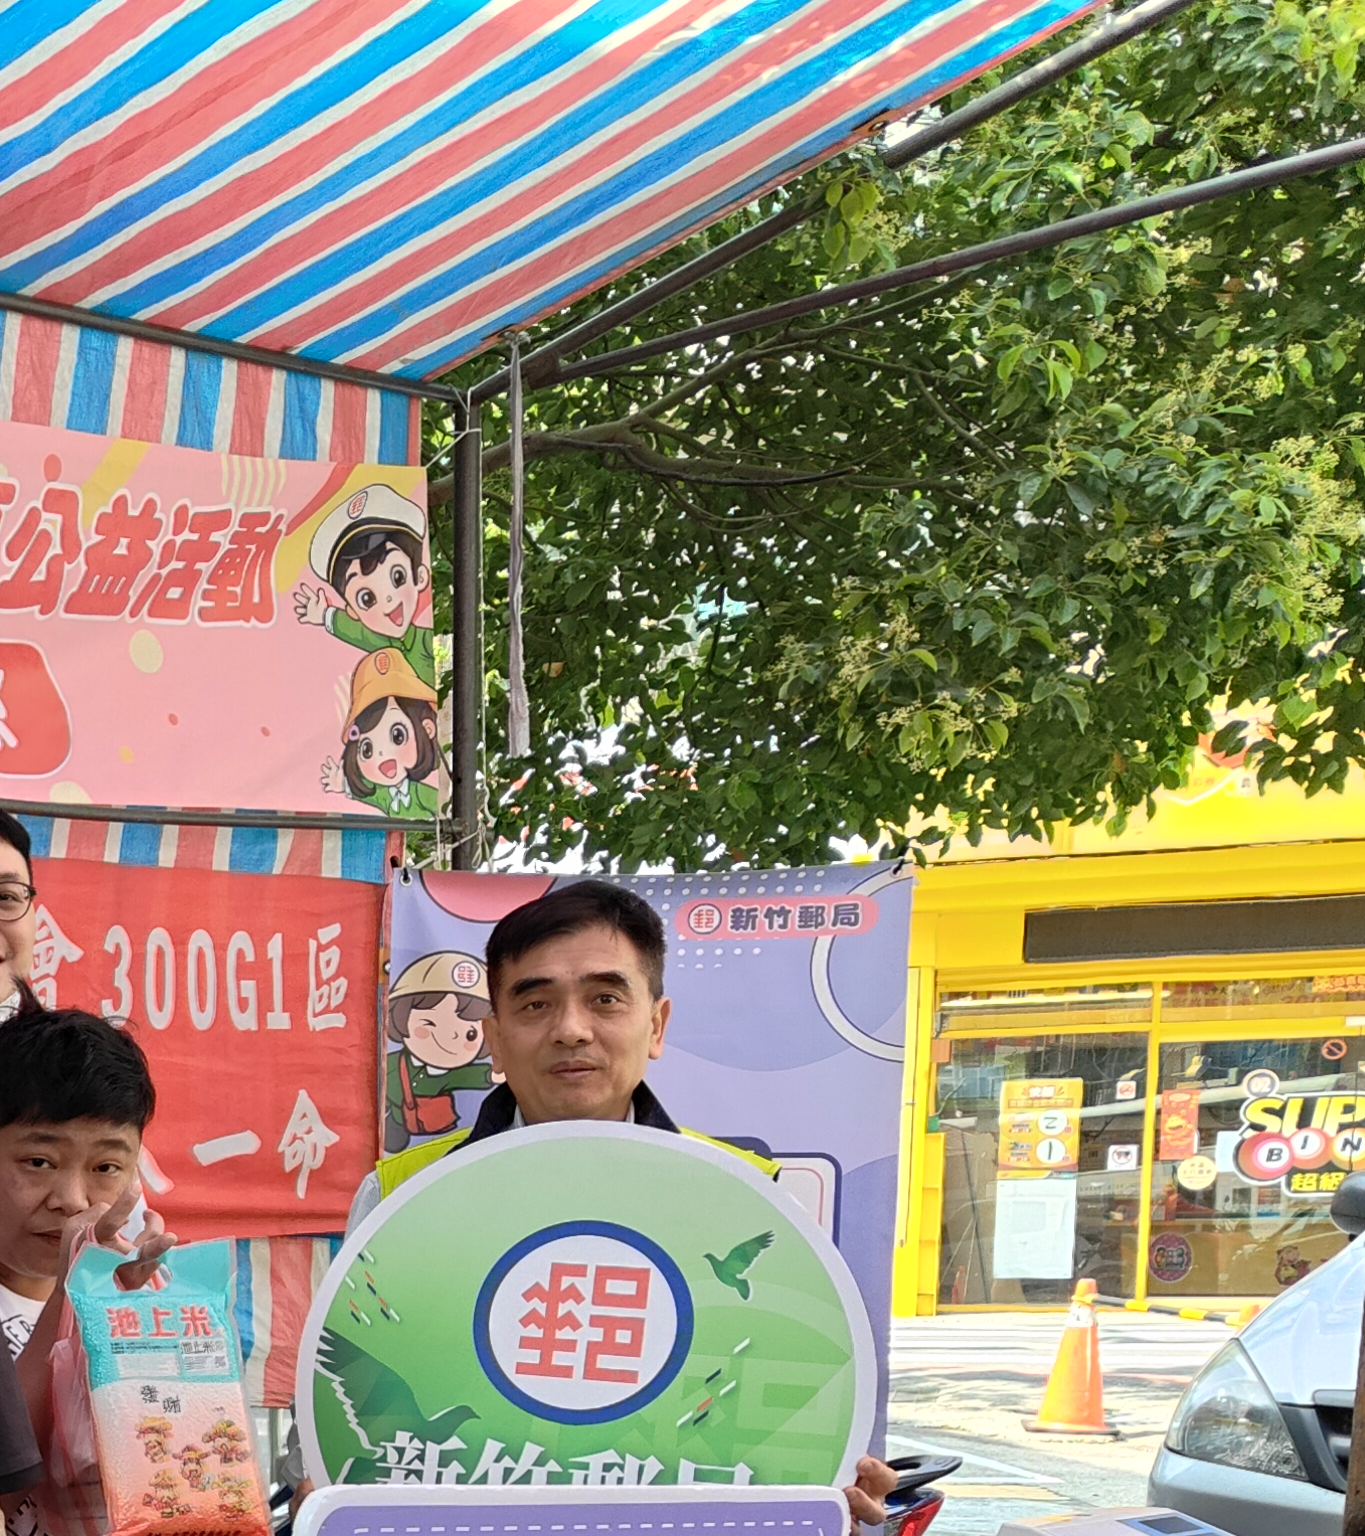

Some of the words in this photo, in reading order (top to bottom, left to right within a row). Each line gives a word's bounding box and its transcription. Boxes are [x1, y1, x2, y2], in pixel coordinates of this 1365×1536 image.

[728, 900, 862, 933] 新竹郵局
[106, 1304, 214, 1339] 池上米
